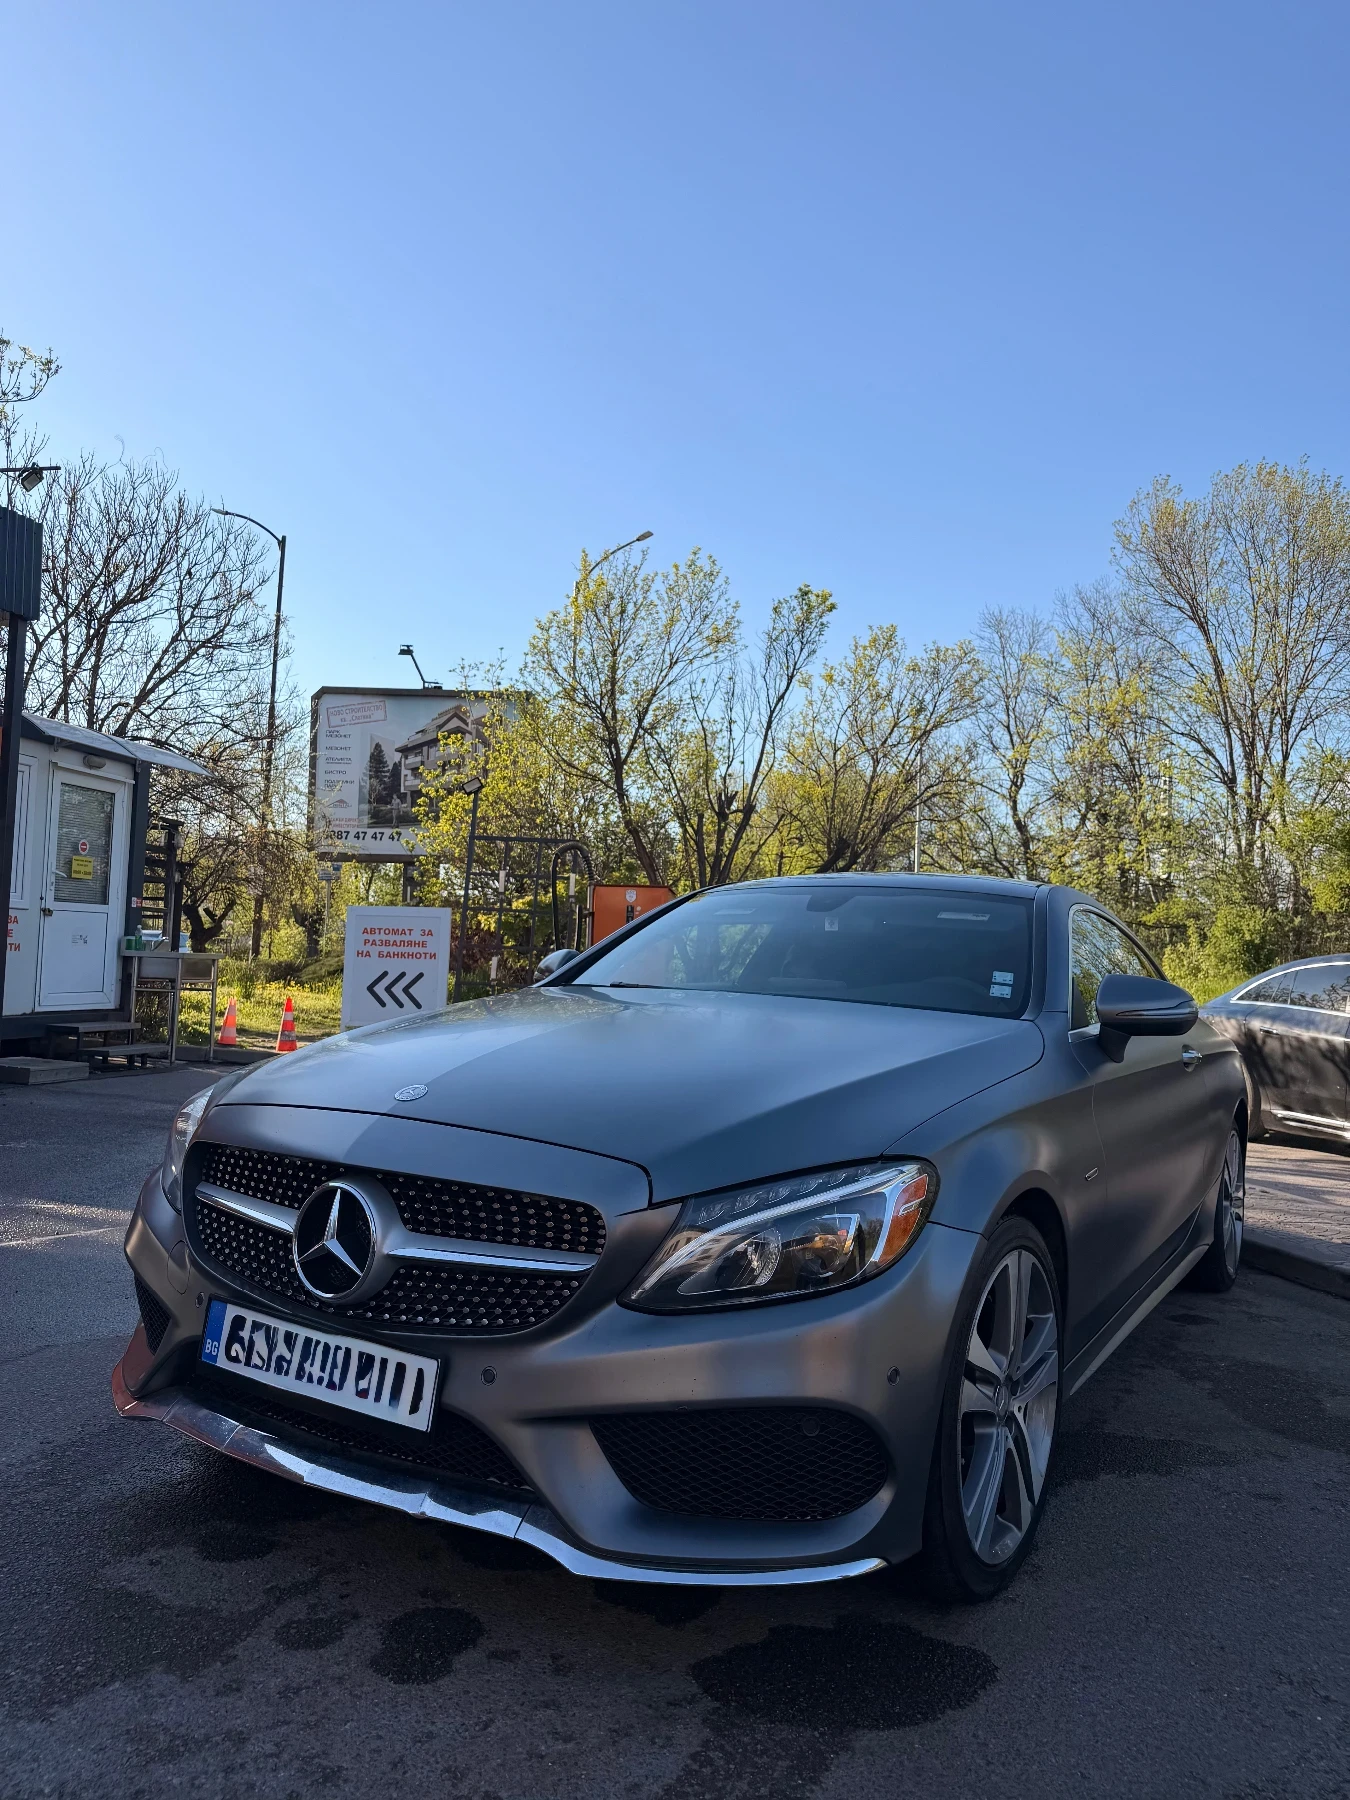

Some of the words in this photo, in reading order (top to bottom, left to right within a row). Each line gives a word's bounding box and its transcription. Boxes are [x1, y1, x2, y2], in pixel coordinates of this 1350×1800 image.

[354, 831, 367, 841] 47
[371, 831, 384, 842] 47
[388, 832, 402, 842] 47
[362, 927, 414, 936] АВТОМАТ
[420, 928, 434, 937] ЗА
[363, 938, 428, 949] РАЗВАЛЯНЕ
[356, 950, 371, 958] НА
[378, 950, 437, 960] БАНКНОТИ
[204, 1337, 219, 1356] BG
